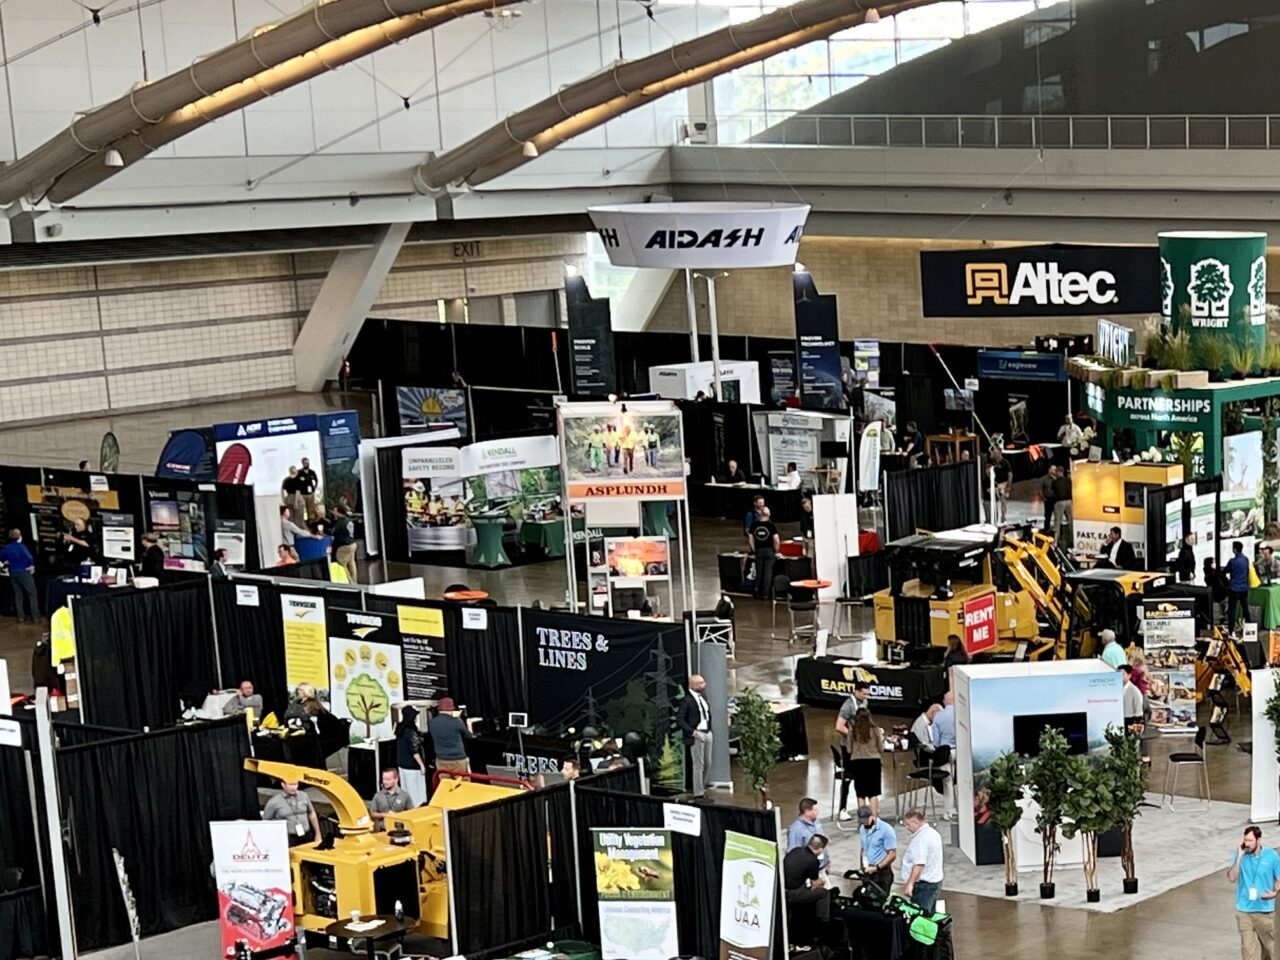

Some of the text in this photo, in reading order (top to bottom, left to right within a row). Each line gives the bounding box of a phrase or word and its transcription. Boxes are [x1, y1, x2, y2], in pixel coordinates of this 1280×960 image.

[645, 228, 765, 249] AIDASH
[453, 240, 482, 258] EXIT
[1191, 318, 1229, 328] WRIGHT
[1117, 396, 1211, 413] PARTNERSHIPS
[1171, 414, 1198, 423] America
[585, 485, 668, 496] ASPLUNDH
[965, 605, 994, 627] RENT
[536, 627, 609, 652] TREES &
[972, 625, 990, 643] ME
[538, 648, 587, 671] LINES
[503, 752, 558, 774] TREES
[599, 832, 665, 848] Utility Vegetation
[607, 846, 659, 862] Management
[734, 908, 761, 929] UAA
